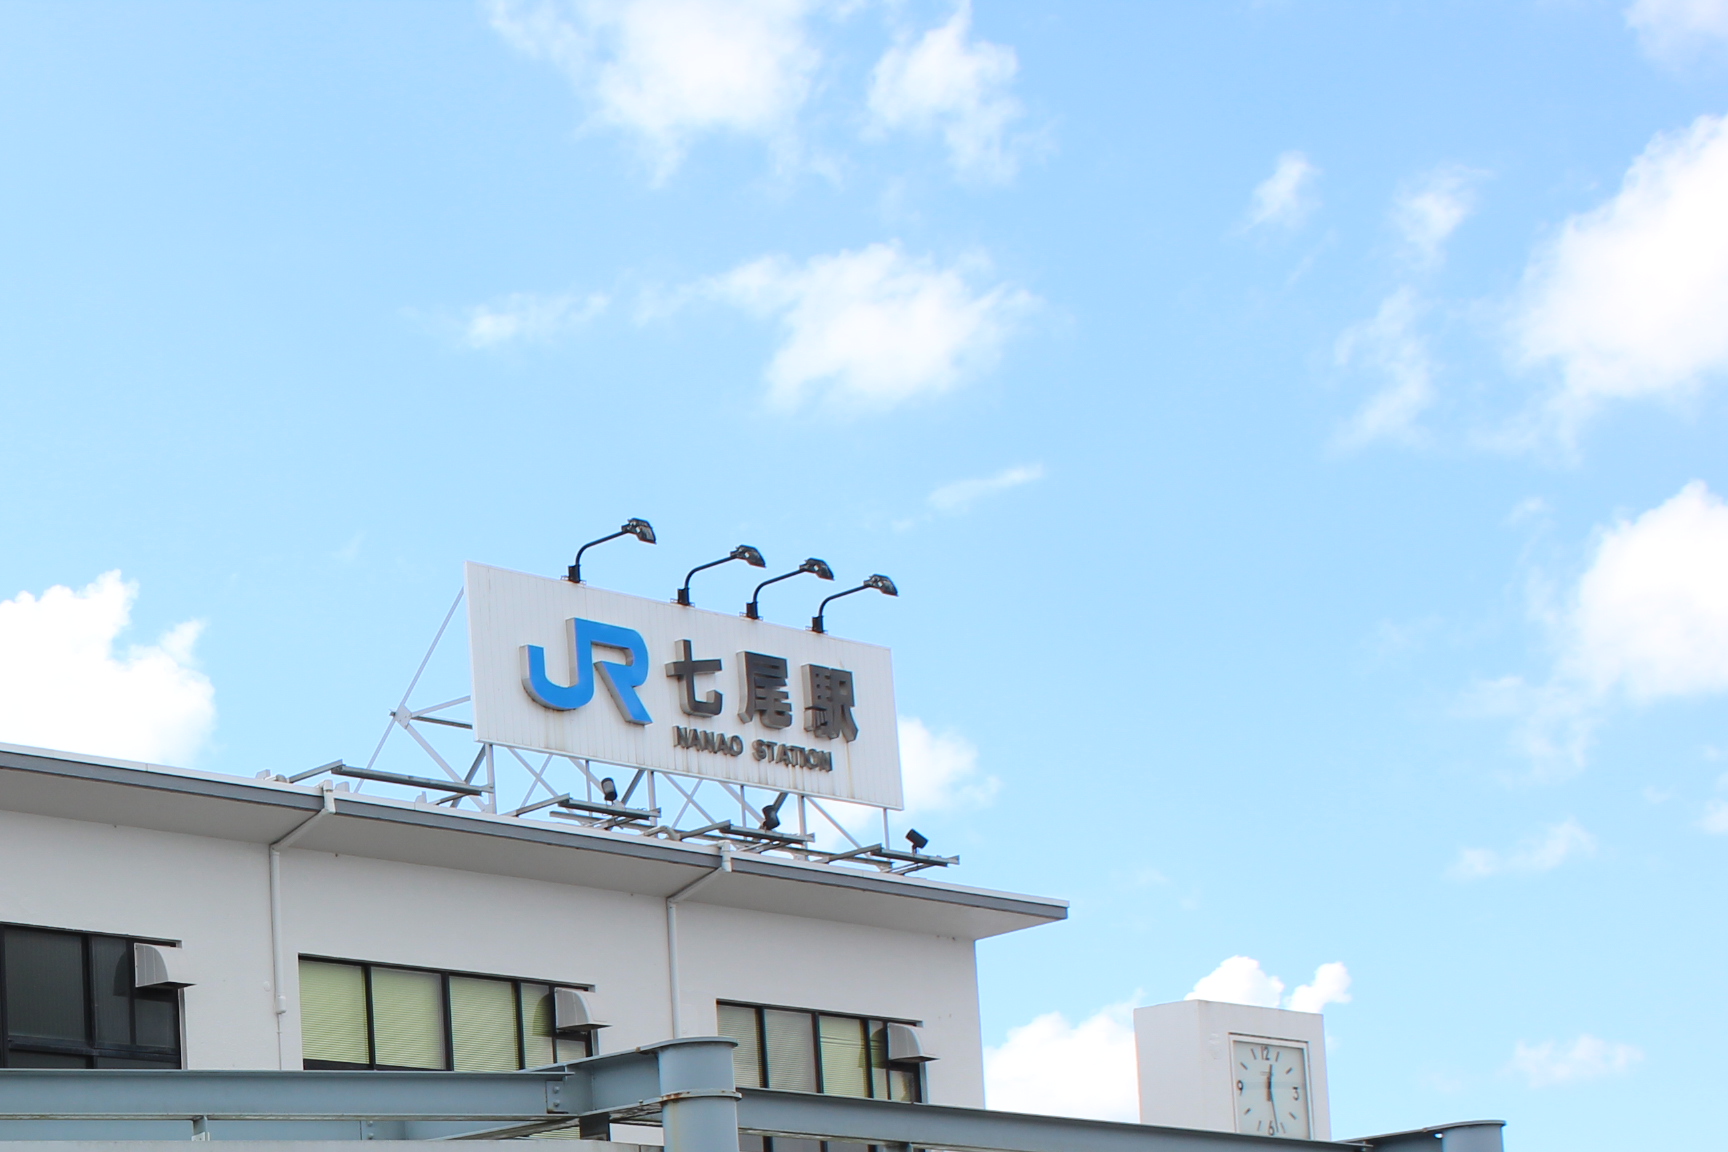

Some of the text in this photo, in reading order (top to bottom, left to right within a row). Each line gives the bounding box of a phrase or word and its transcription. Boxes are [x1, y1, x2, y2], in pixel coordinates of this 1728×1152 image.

[520, 617, 652, 725] JR
[666, 639, 858, 742] 七尾駅
[673, 725, 832, 772] NANAO STATION
[1261, 1046, 1270, 1061] 12
[1237, 1080, 1244, 1096] 9
[1293, 1086, 1300, 1101] 3
